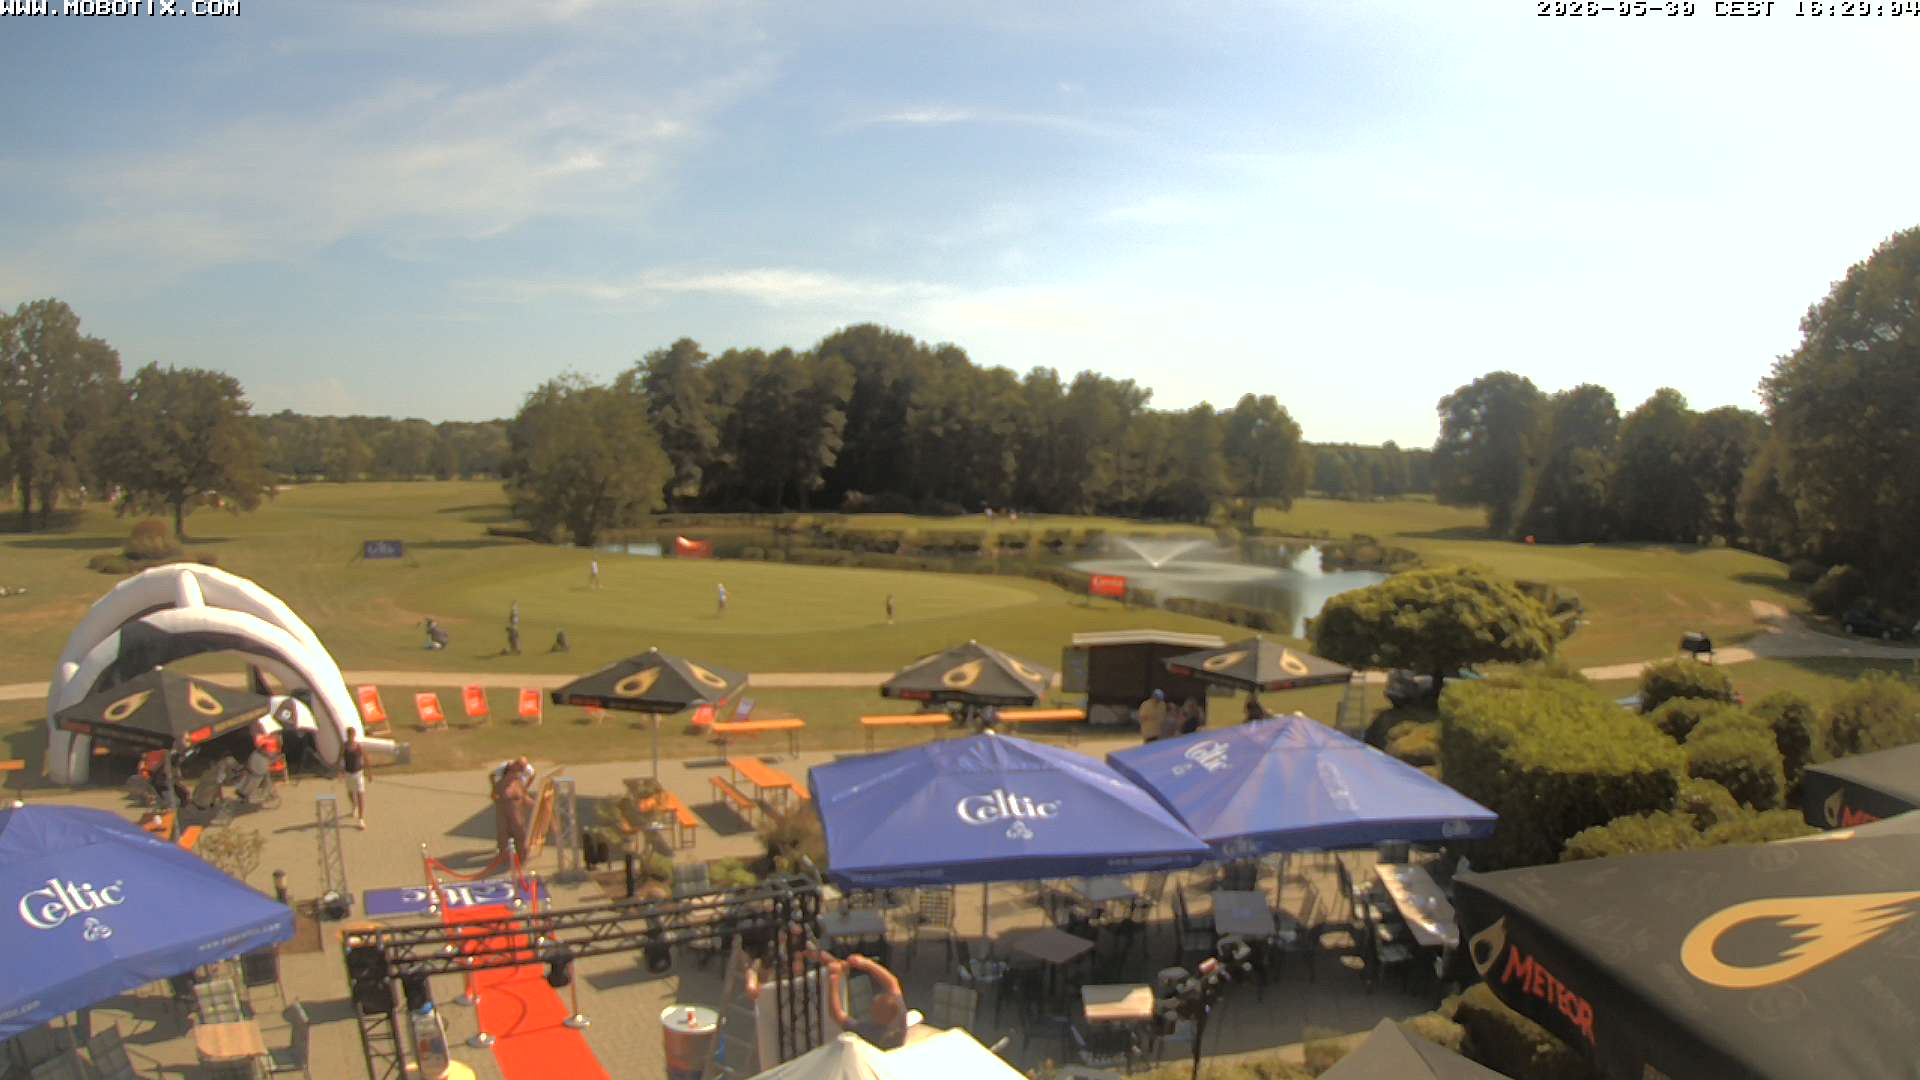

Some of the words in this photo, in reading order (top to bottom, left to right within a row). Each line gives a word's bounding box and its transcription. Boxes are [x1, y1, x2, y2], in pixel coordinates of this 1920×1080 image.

[957, 788, 1059, 824] Celtic
[18, 878, 125, 928] Celtic
[1501, 943, 1596, 1048] METEOR
